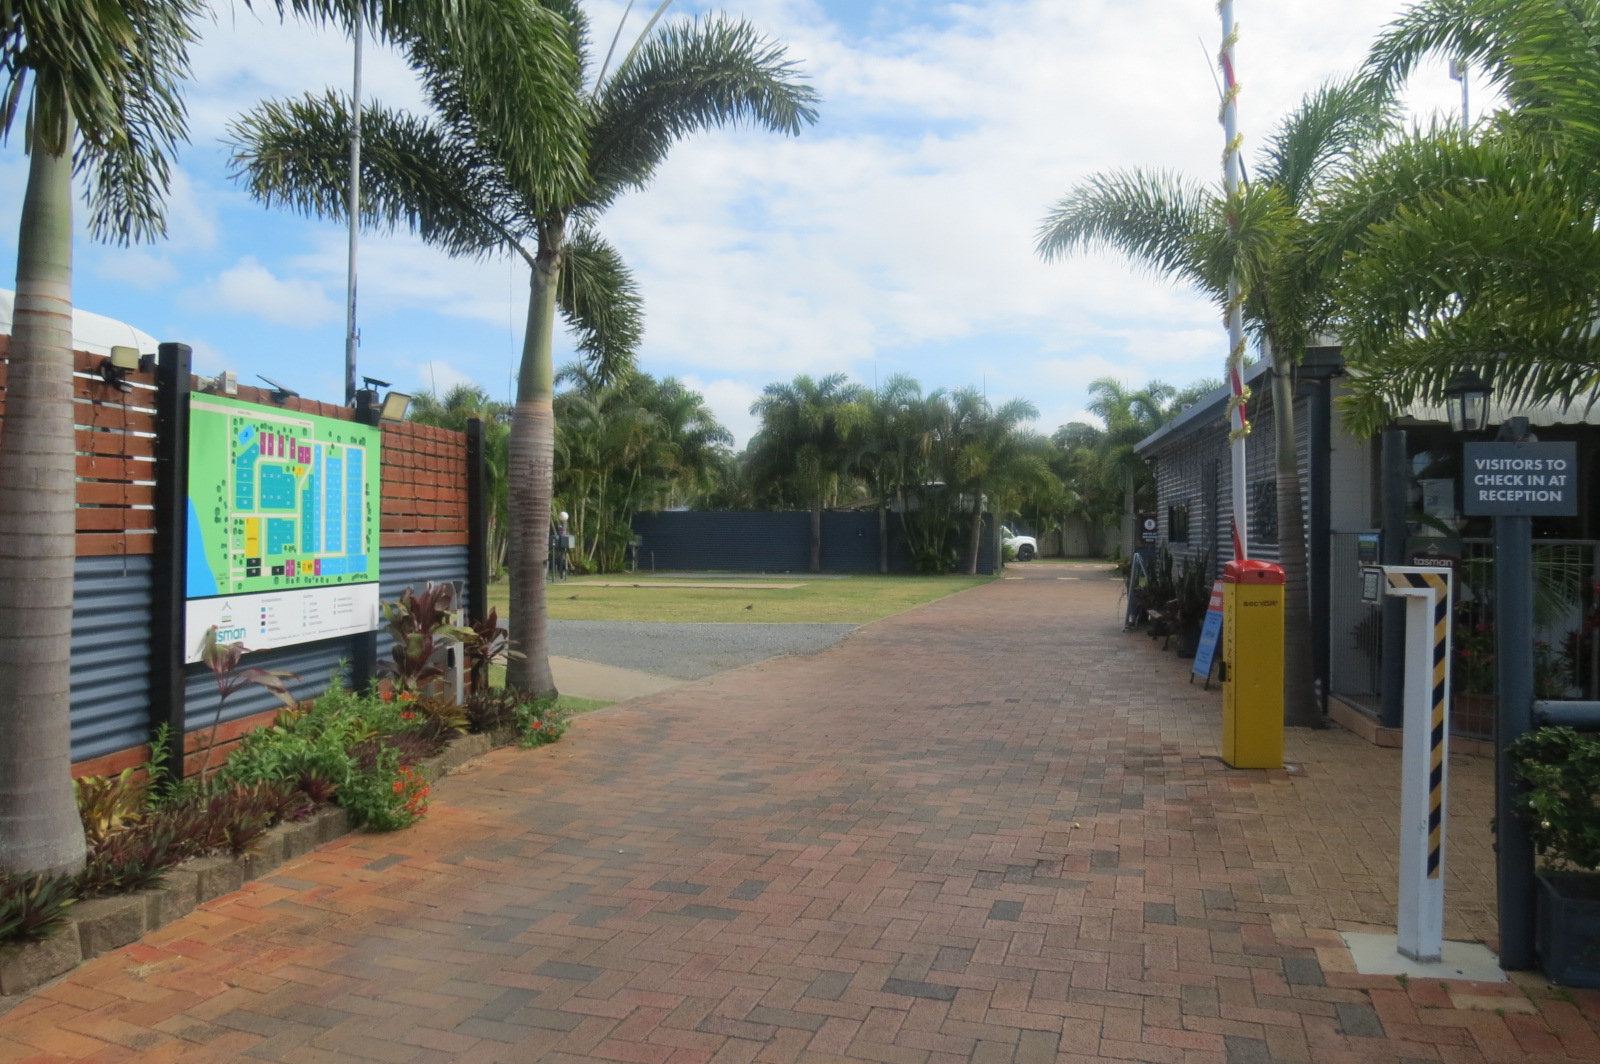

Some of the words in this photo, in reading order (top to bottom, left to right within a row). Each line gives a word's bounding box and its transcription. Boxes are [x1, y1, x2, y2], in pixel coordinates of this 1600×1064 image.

[1475, 459, 1542, 470] VISITORS
[1546, 459, 1566, 471] TO
[1474, 474, 1523, 486] CHECK
[1527, 475, 1544, 486] IN
[1548, 475, 1567, 486] AT
[1479, 490, 1562, 501] RECEPTION
[1413, 557, 1452, 567] tasman
[211, 627, 247, 643] sman
